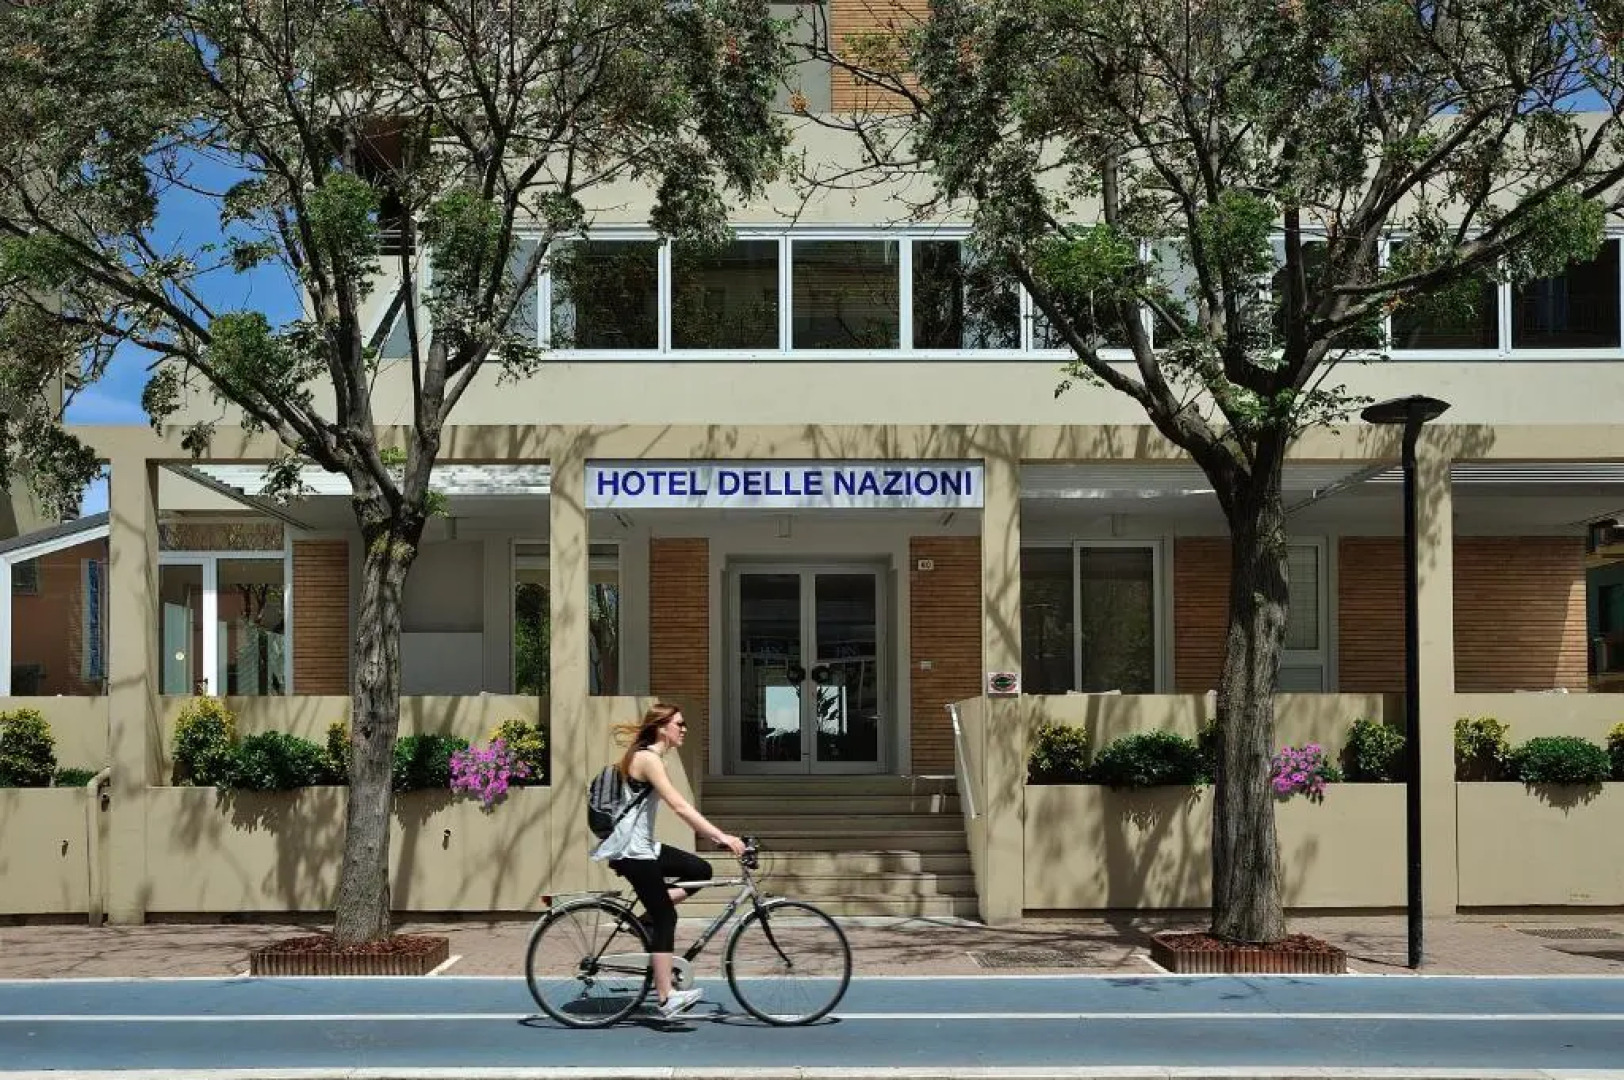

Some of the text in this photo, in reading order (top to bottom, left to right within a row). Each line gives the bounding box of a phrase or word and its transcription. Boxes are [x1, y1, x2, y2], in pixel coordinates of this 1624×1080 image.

[597, 470, 972, 496] HOTEL DELLE NAZIONI
